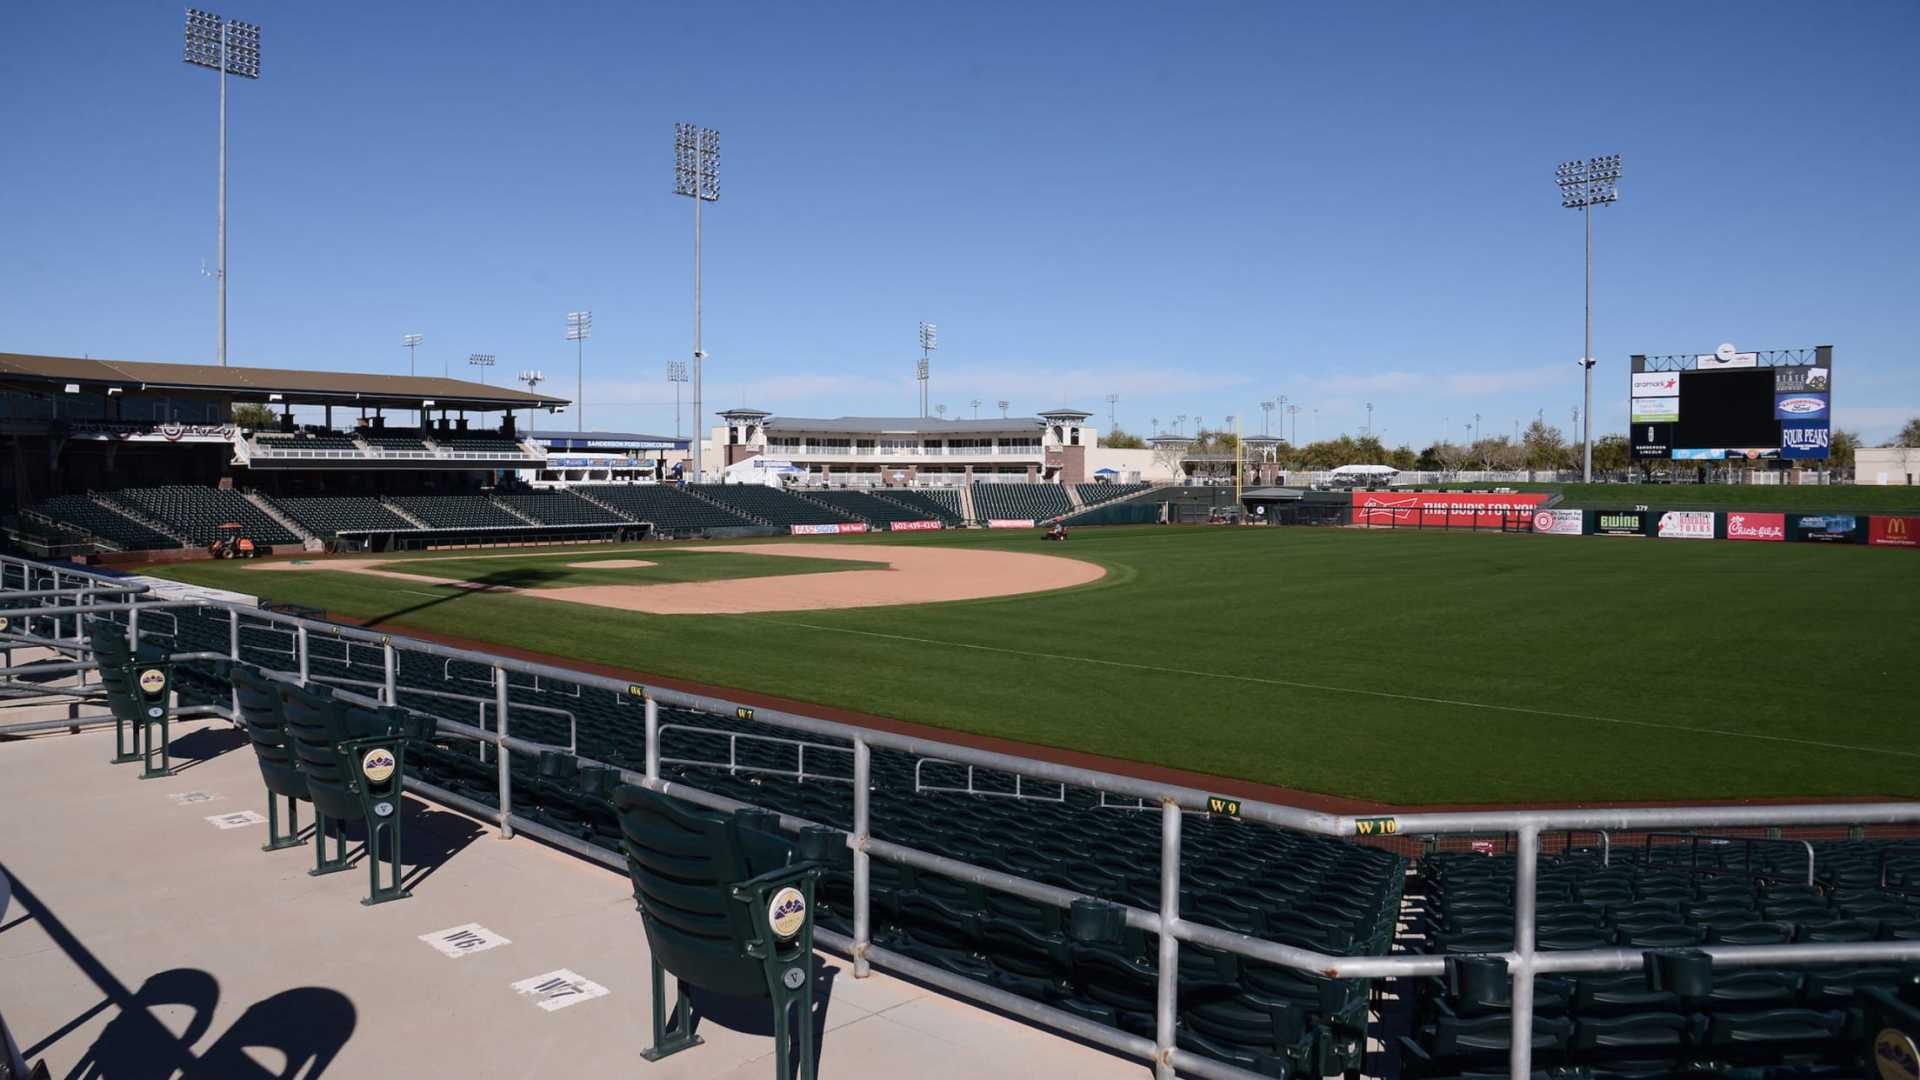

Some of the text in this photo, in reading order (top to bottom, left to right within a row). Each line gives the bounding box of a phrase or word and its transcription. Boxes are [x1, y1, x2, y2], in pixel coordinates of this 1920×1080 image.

[1783, 428, 1829, 448] FOUR PEAKS
[1423, 502, 1448, 515] THIS
[1488, 503, 1511, 516] FOR
